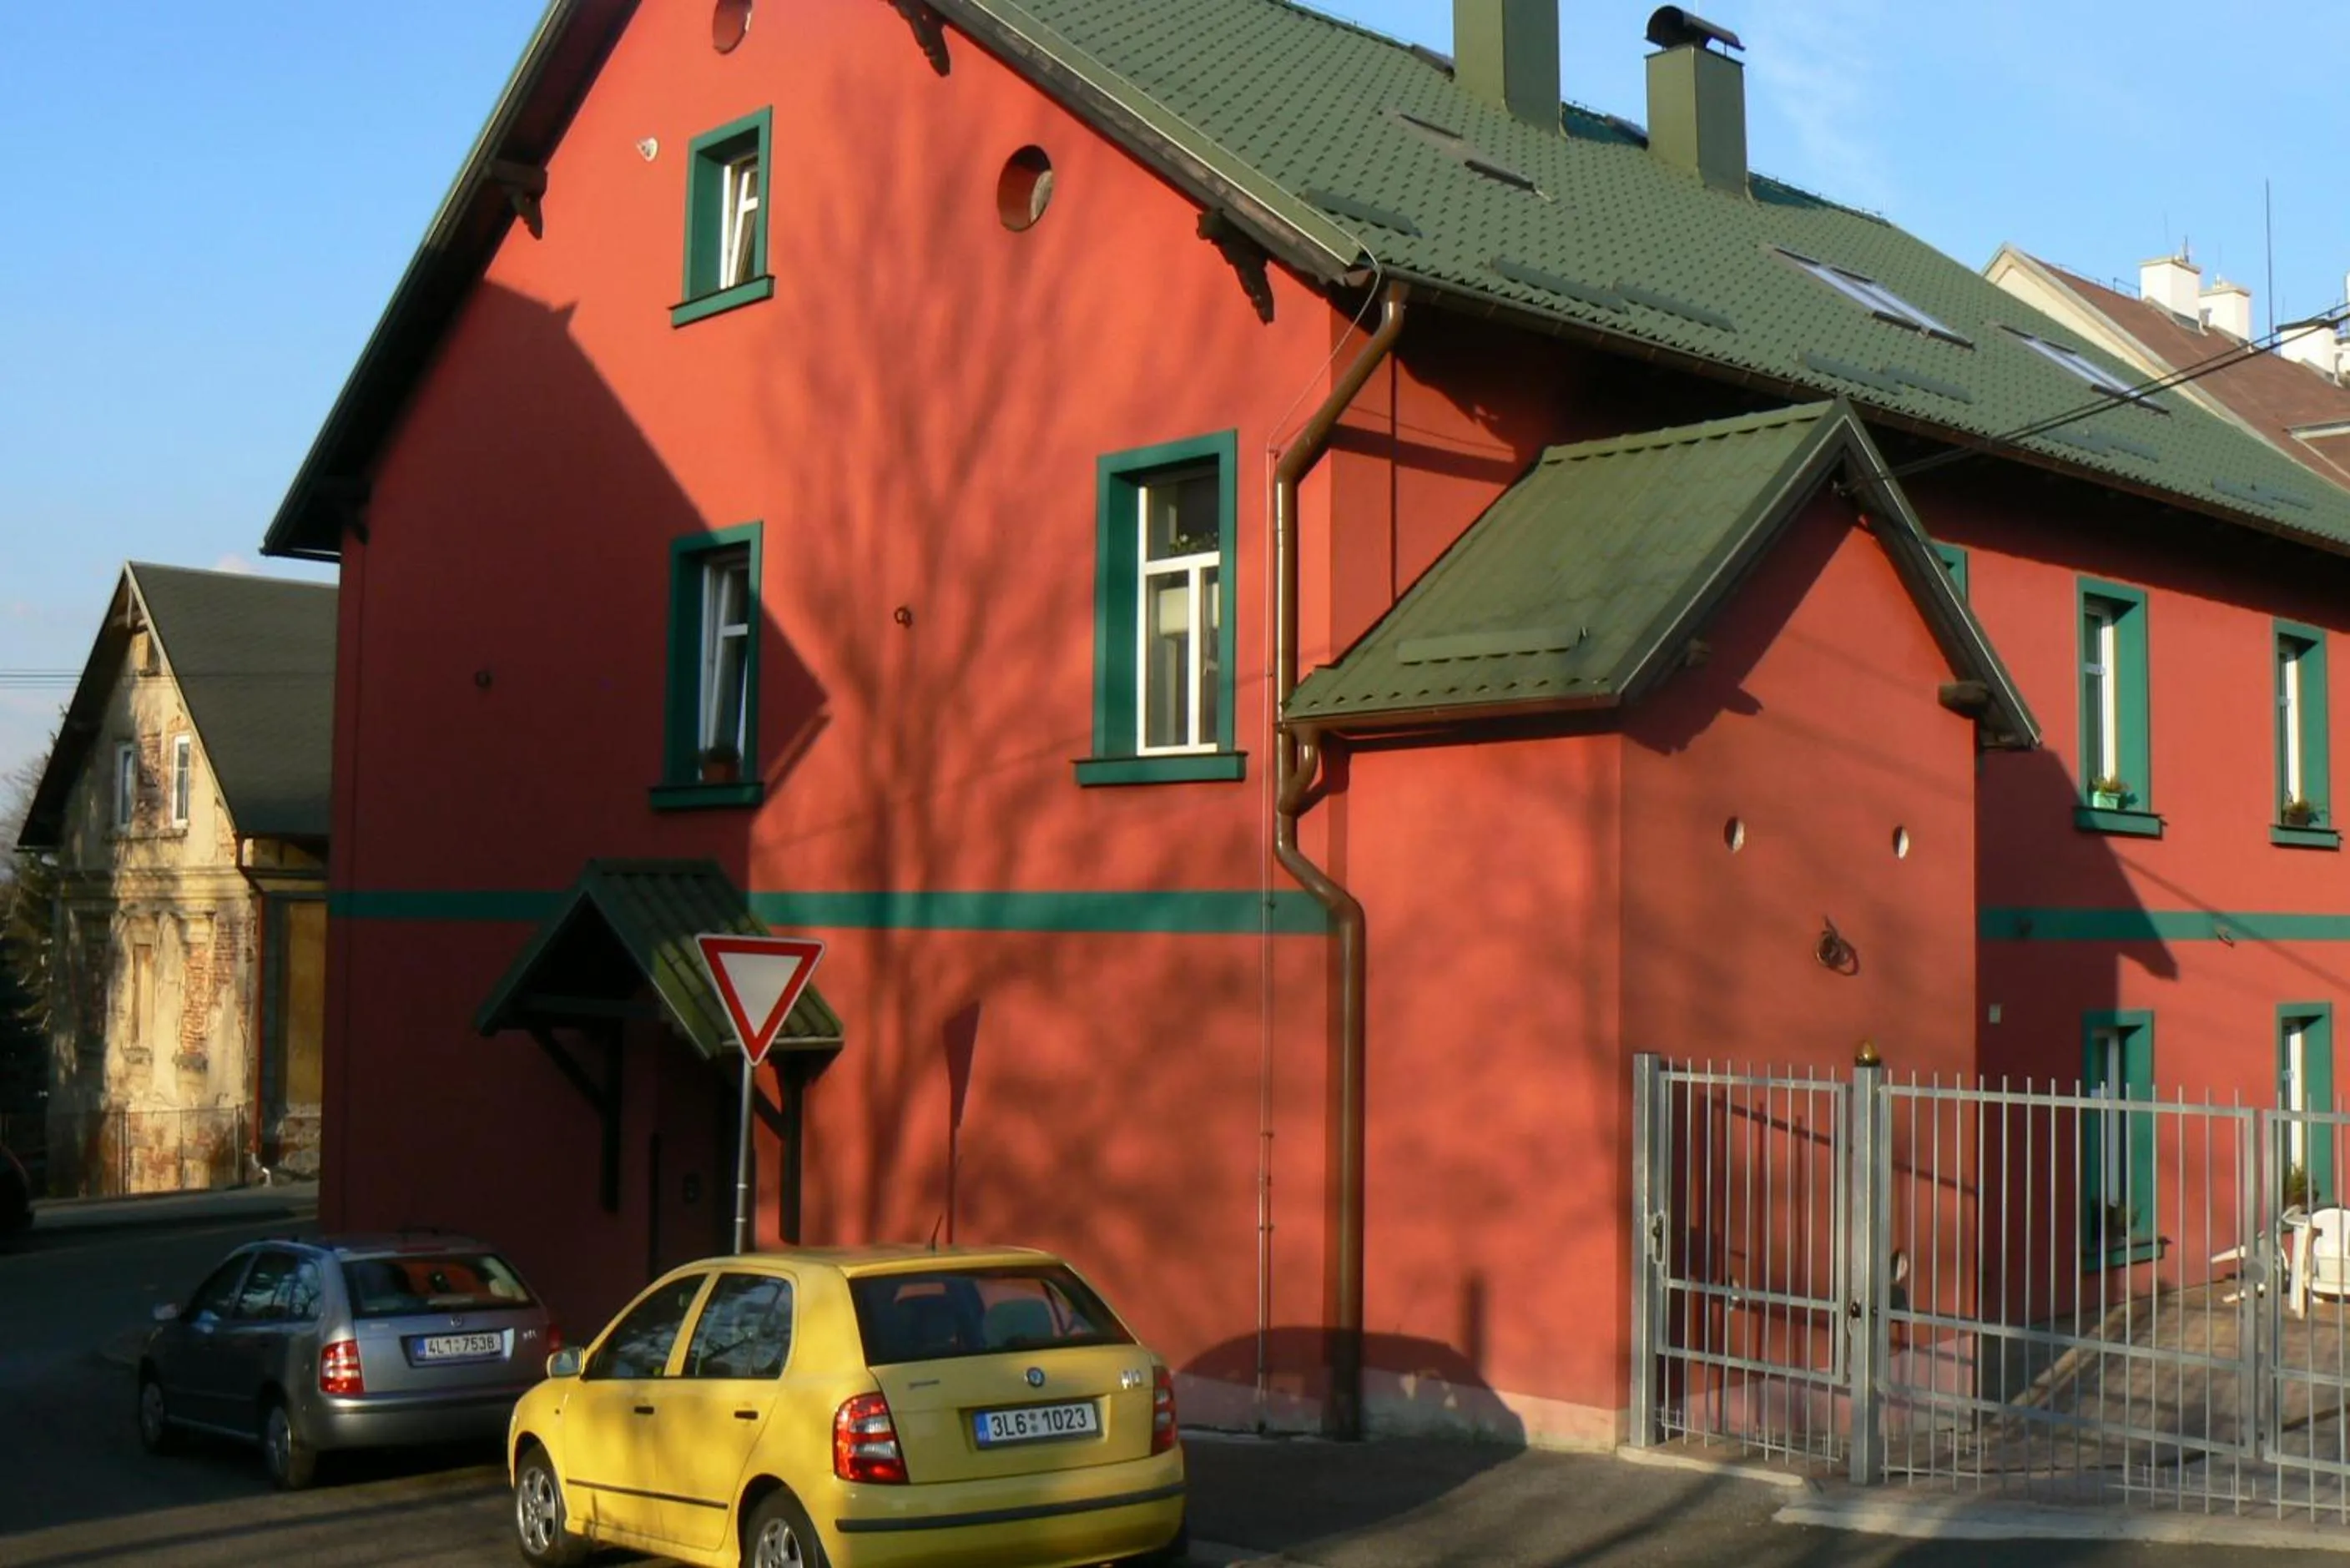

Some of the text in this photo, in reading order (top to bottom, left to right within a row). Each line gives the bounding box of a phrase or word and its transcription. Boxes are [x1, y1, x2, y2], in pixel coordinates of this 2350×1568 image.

[427, 1339, 452, 1354] 4L1
[991, 1414, 1026, 1437] 3L6
[1042, 1408, 1087, 1432] 1023
